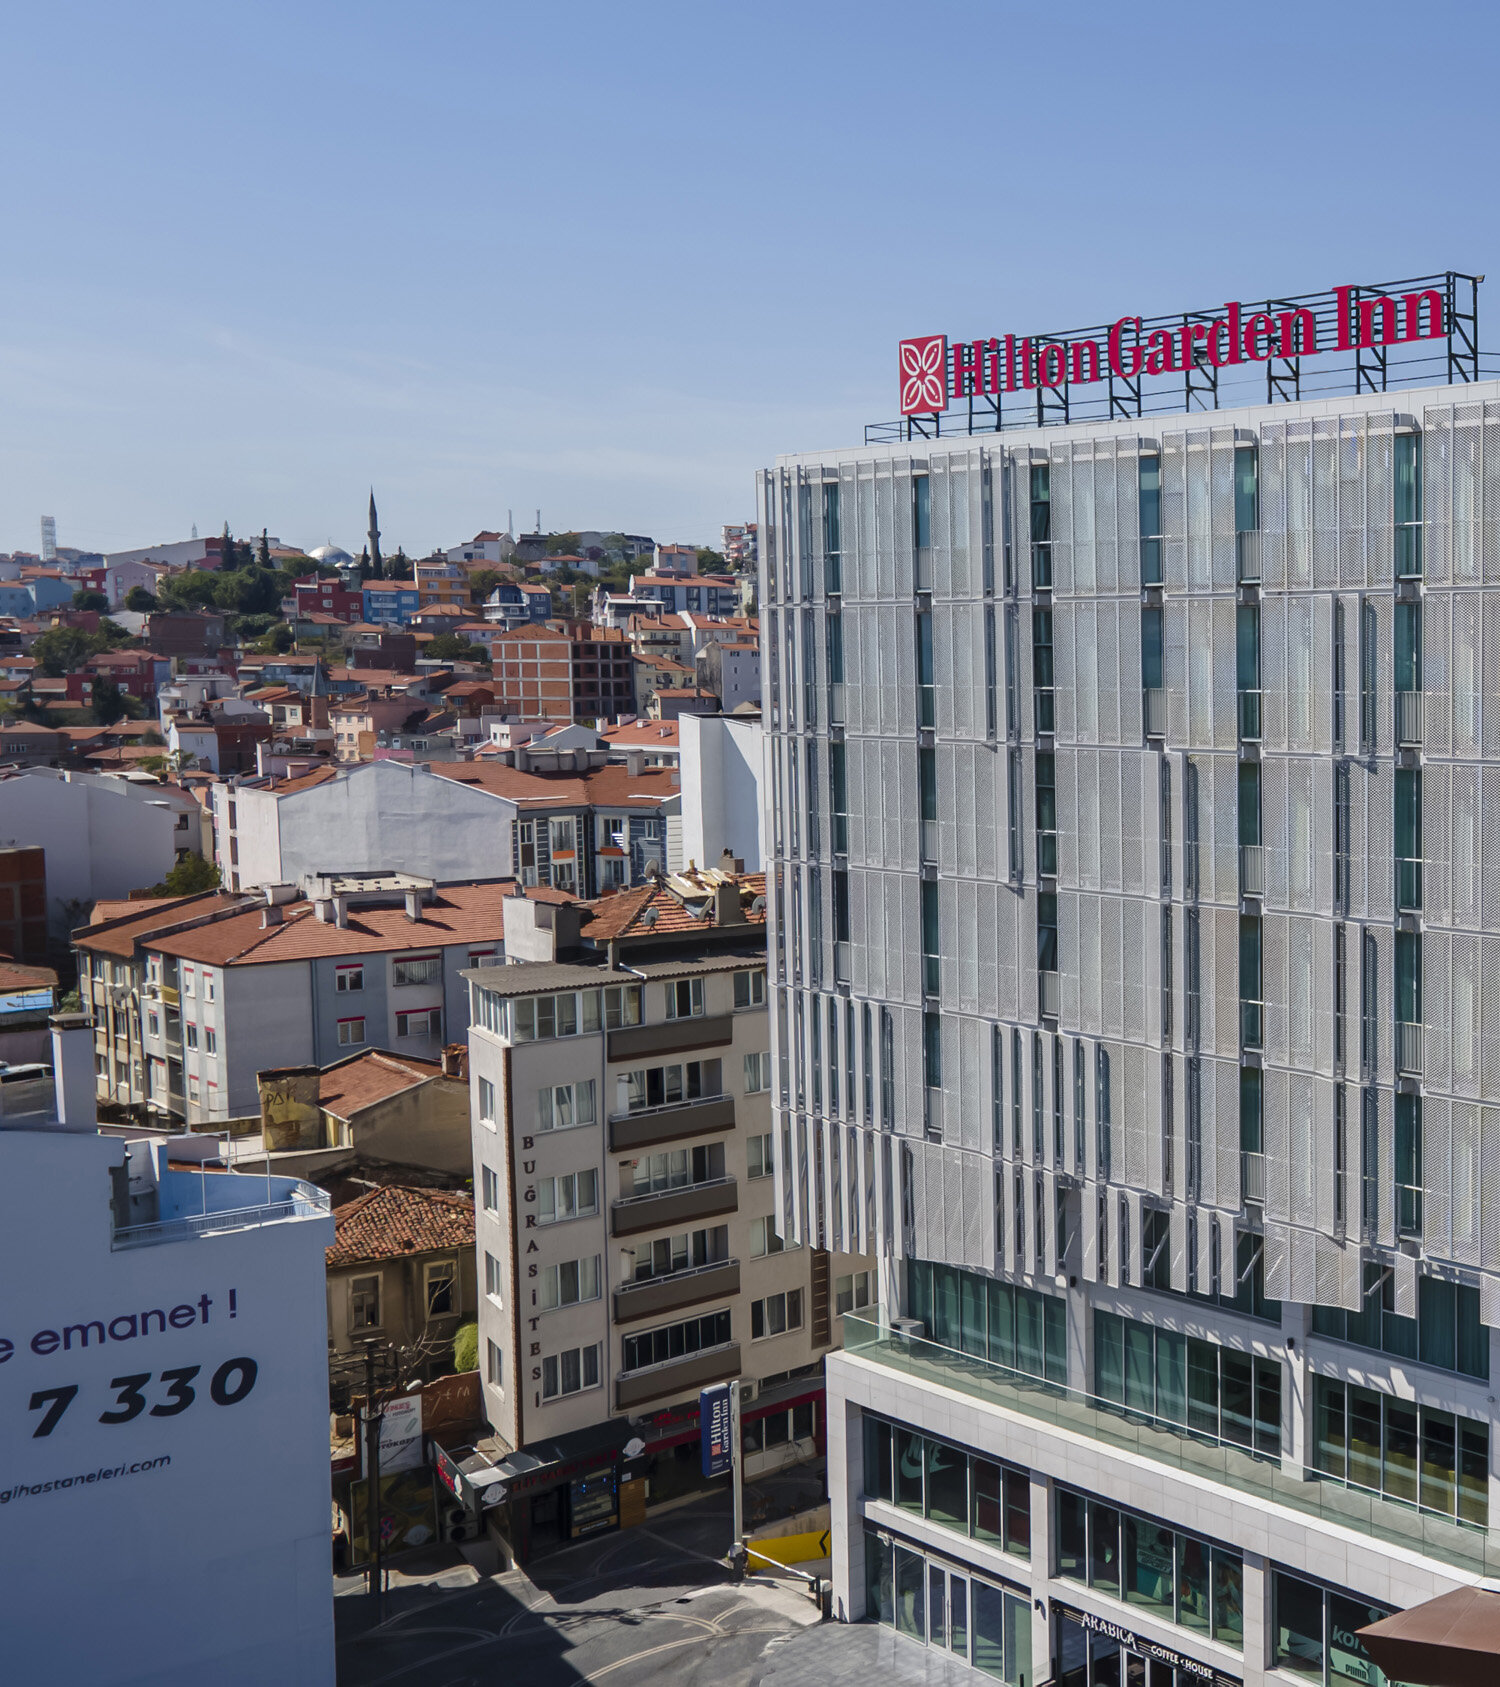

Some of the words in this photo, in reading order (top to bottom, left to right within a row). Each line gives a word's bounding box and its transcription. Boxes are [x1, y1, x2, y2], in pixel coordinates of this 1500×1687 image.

[953, 333, 1102, 399] Hilton
[1109, 302, 1318, 380] Garden
[1332, 285, 1450, 353] Inn
[30, 1294, 213, 1355] emanet
[29, 1384, 79, 1439] 7
[98, 1357, 258, 1424] 330
[711, 1400, 721, 1445] Hilton
[0, 1455, 171, 1503] gihastaneleri.com
[1081, 1612, 1137, 1650] ARABICA
[1150, 1645, 1179, 1665] COFFEE
